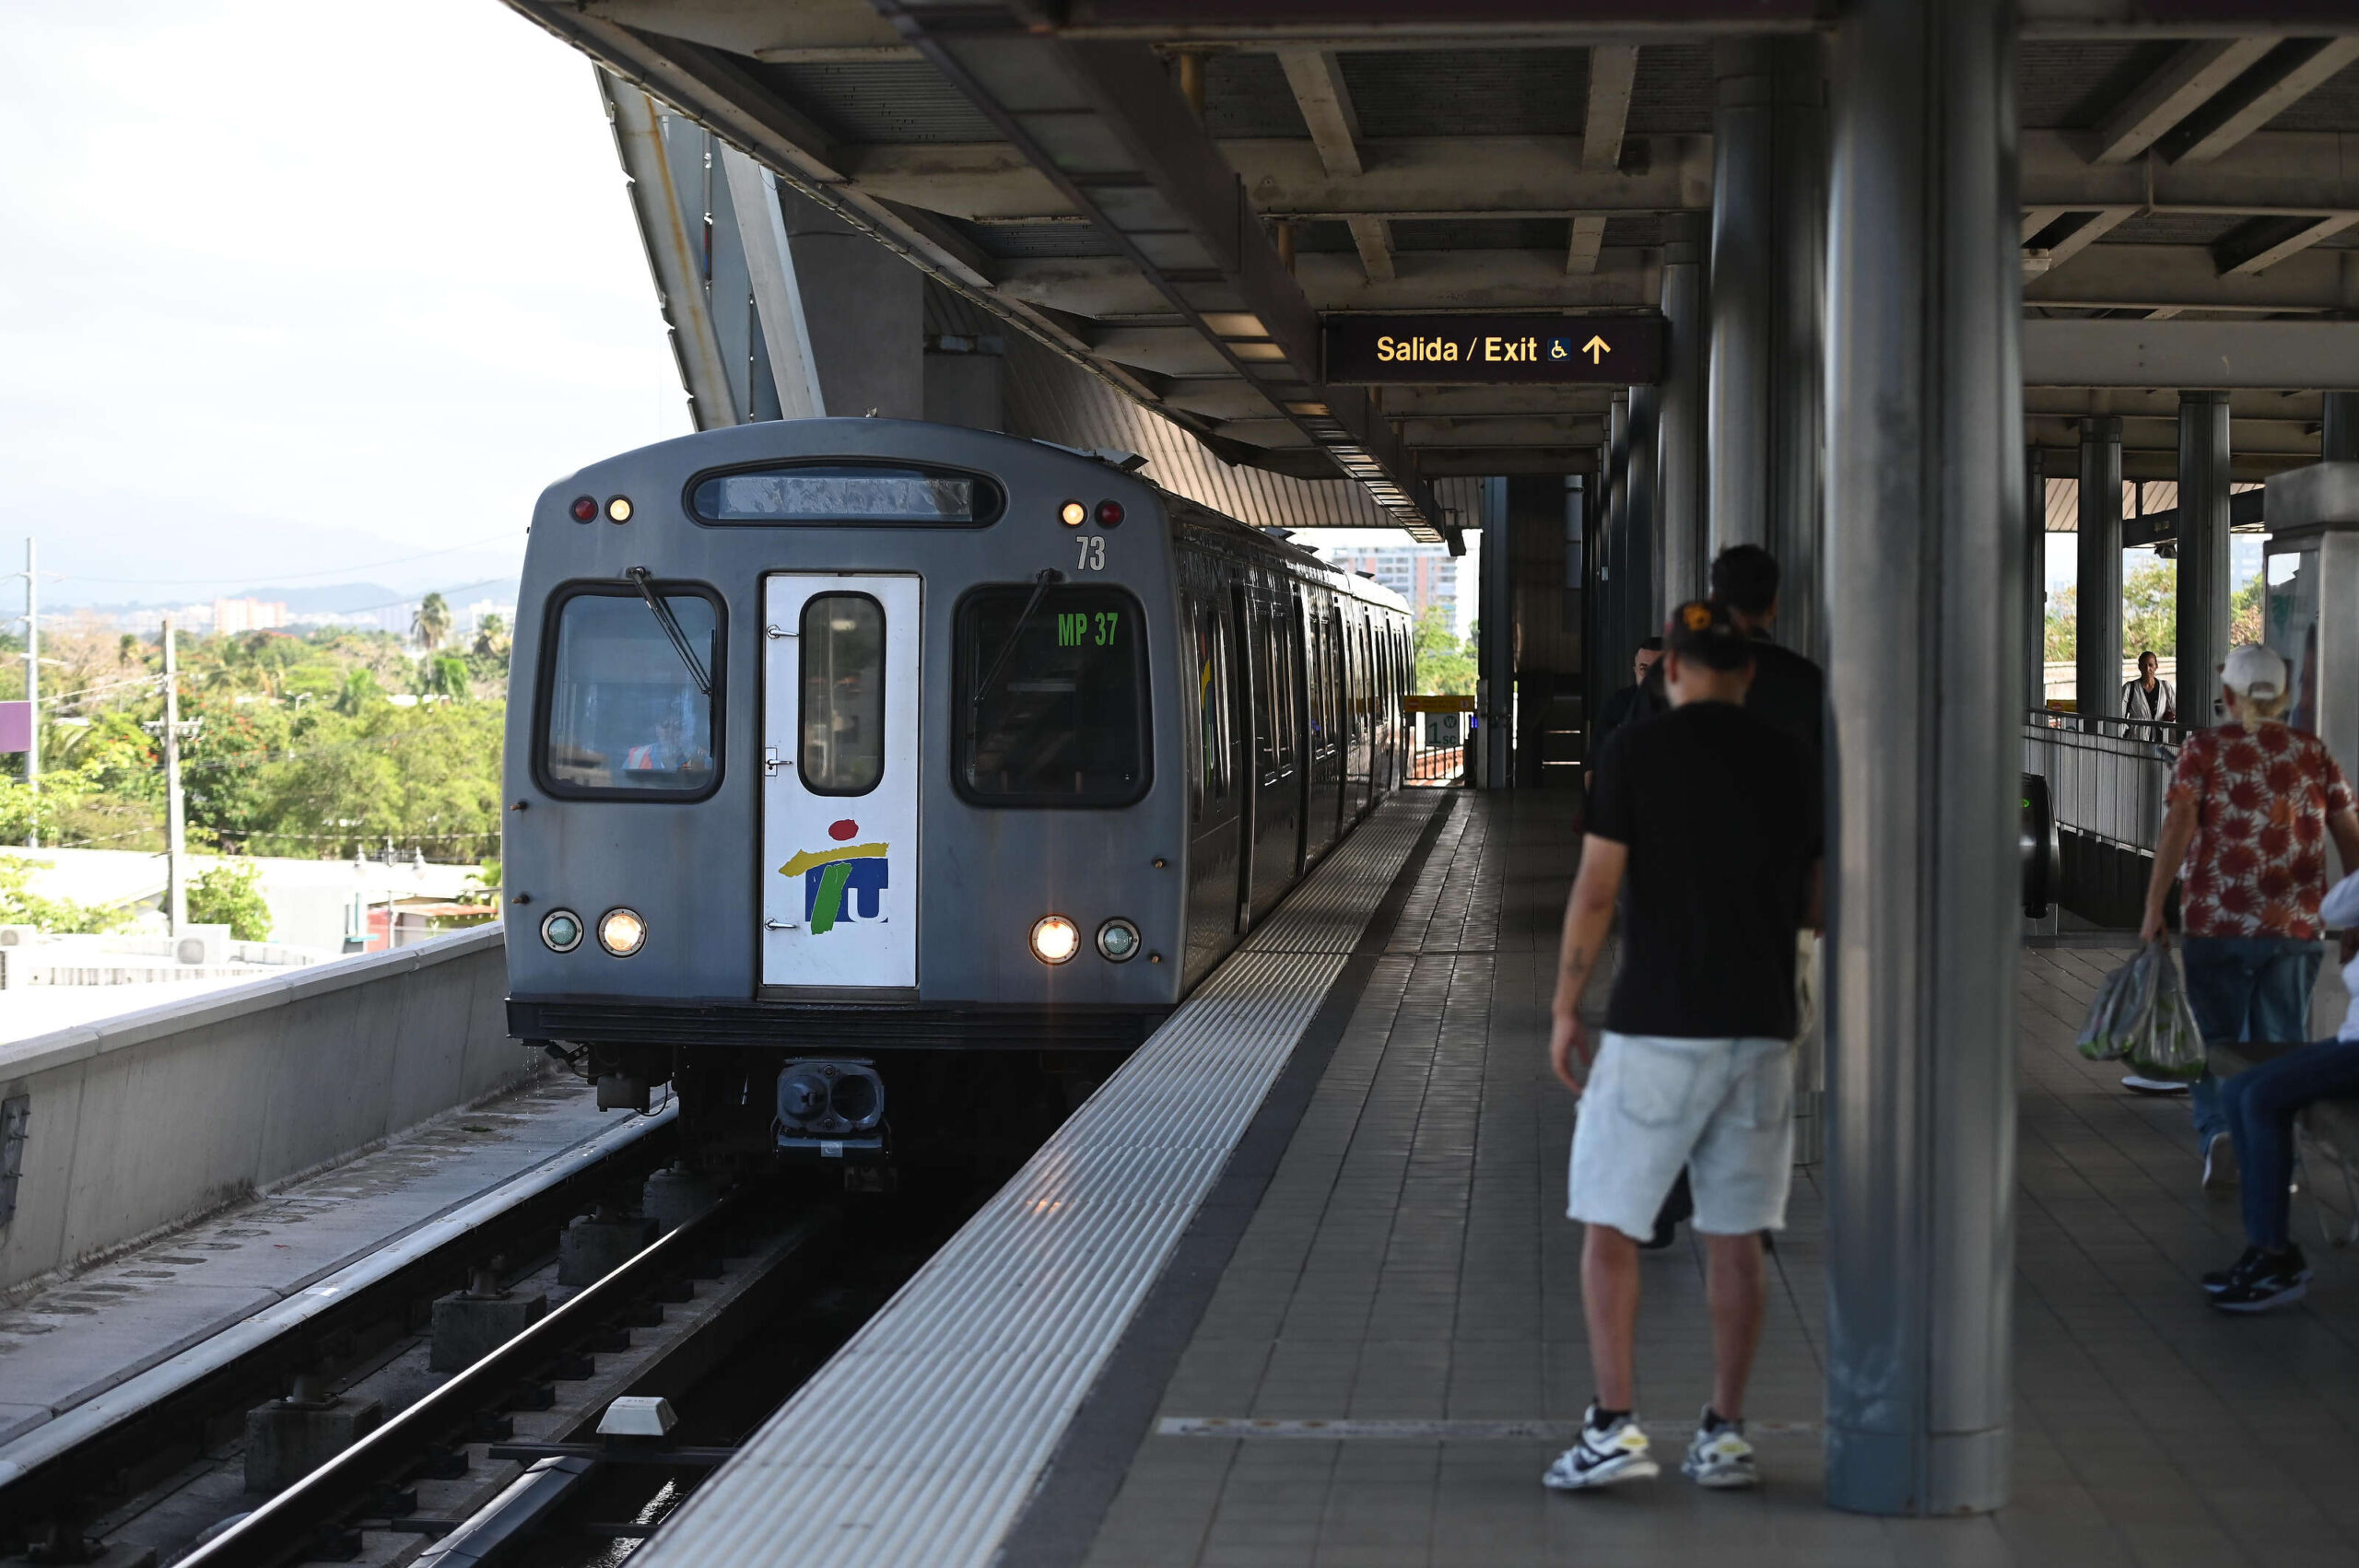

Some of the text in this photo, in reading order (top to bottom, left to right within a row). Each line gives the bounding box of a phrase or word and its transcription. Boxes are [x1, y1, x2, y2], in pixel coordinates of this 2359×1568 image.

[1377, 335, 1538, 361] Salida / Exit
[1075, 535, 1106, 571] 73
[1058, 612, 1119, 647] MP 37
